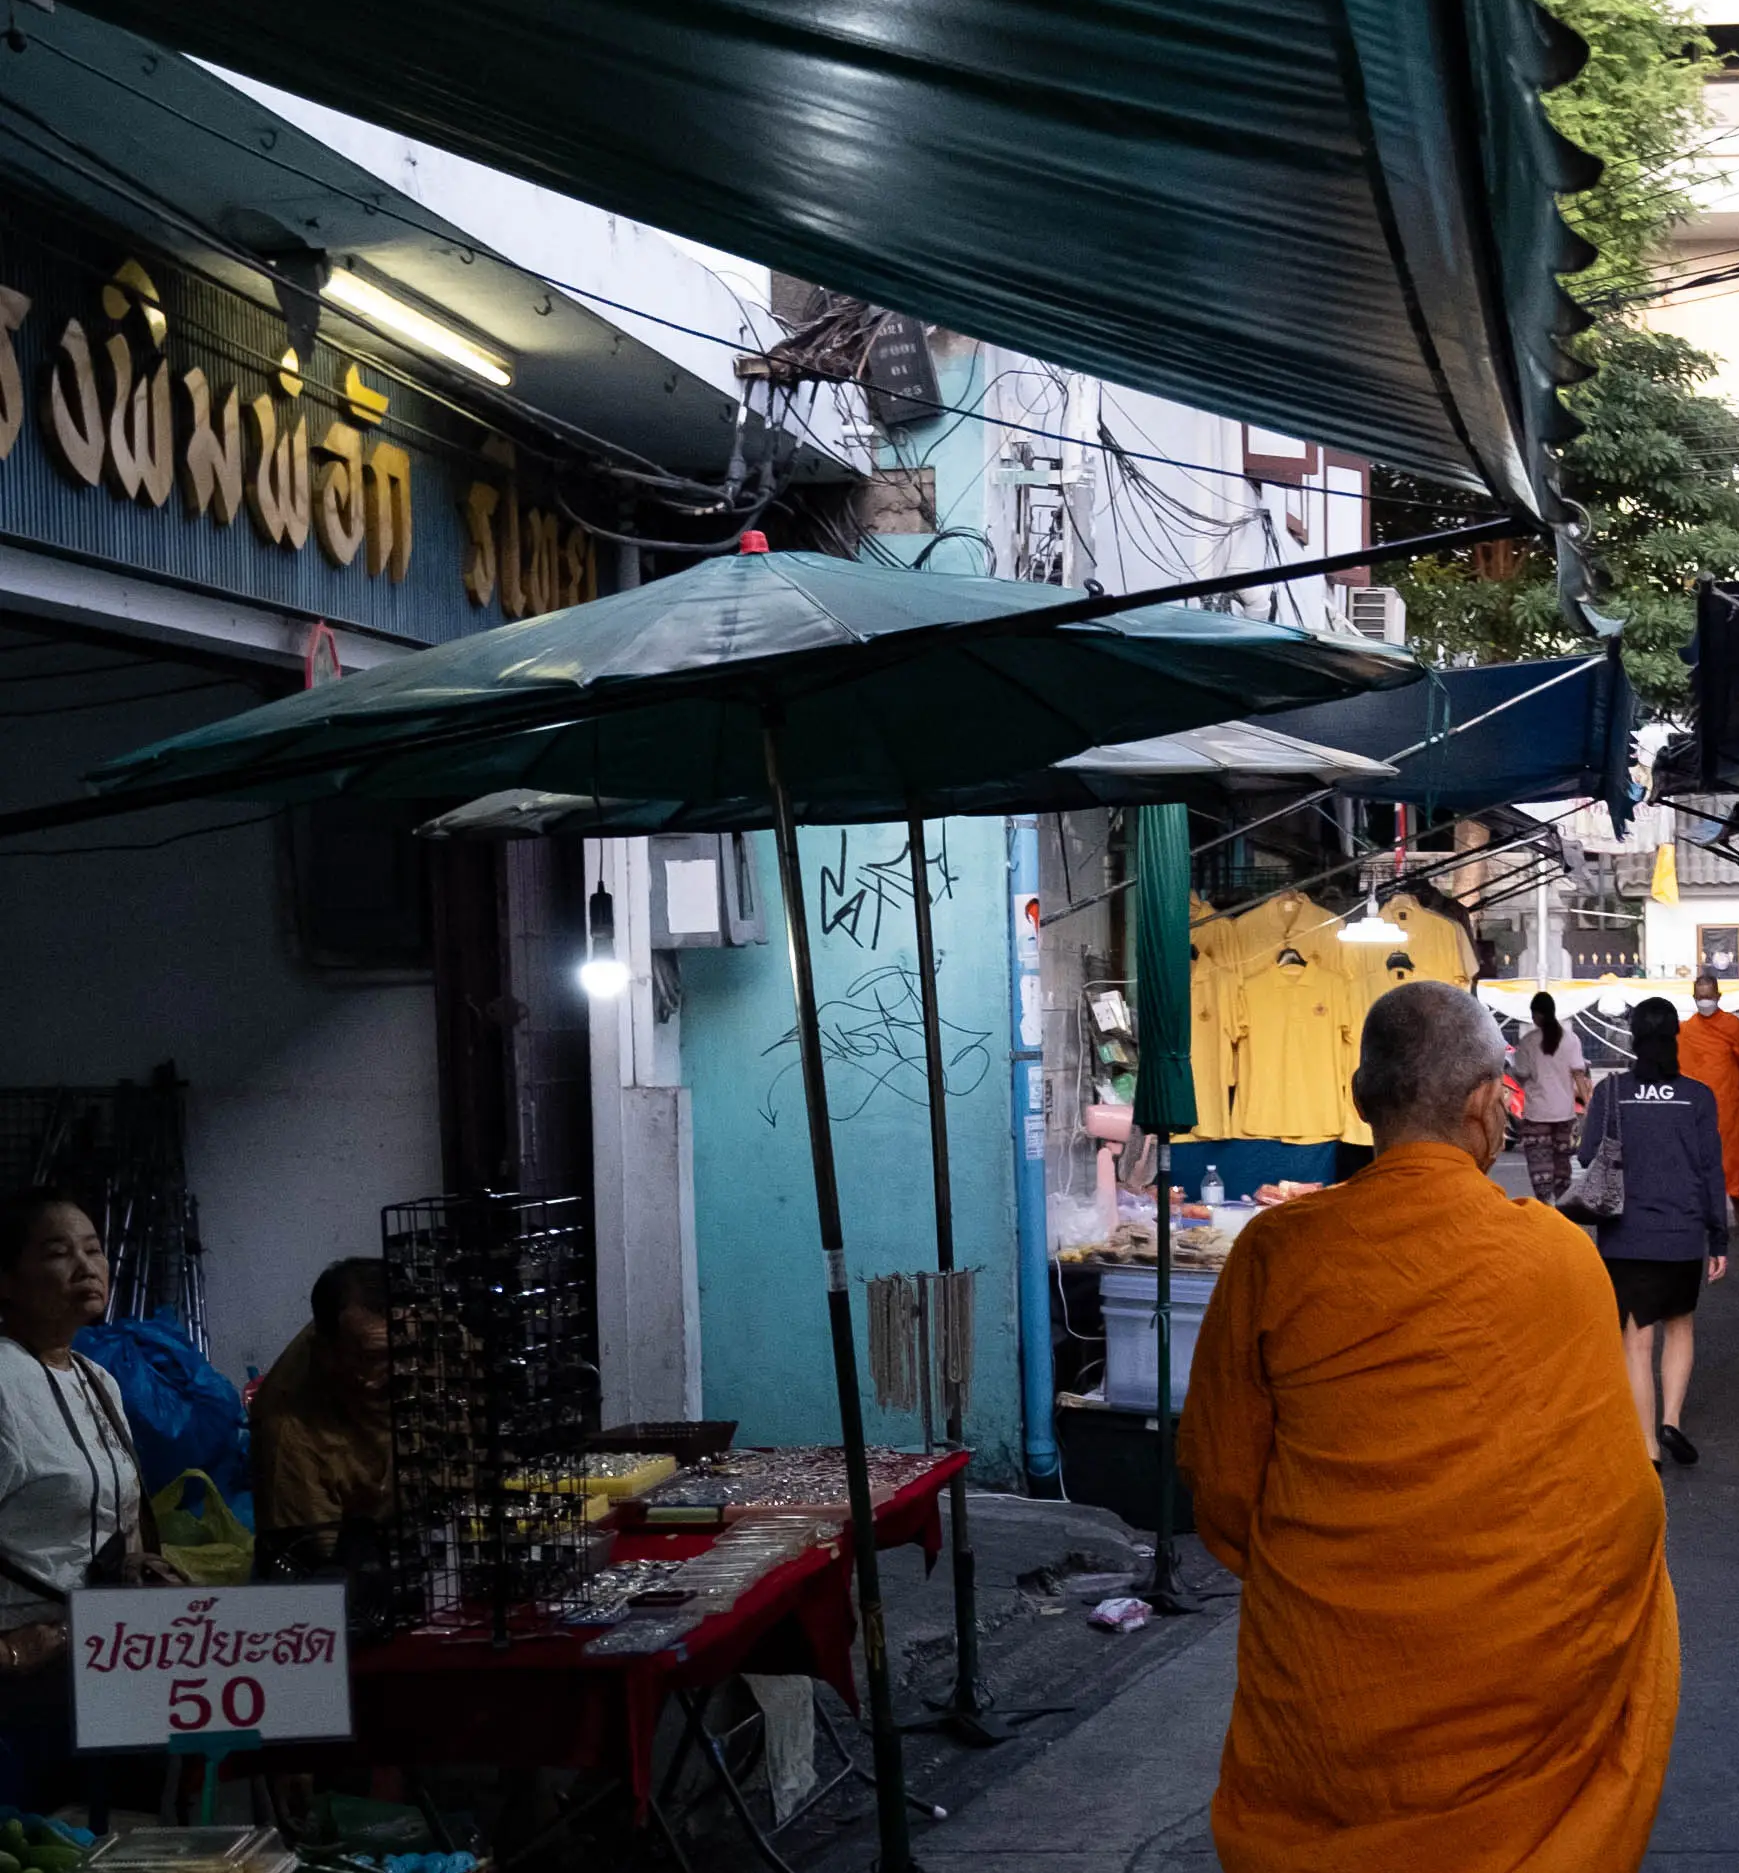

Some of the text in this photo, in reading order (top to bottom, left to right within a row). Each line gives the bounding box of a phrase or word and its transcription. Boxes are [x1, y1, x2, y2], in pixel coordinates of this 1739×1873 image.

[1634, 1084, 1675, 1100] JAG
[85, 1597, 337, 1672] ปอเปี๊ยะสด
[168, 1676, 267, 1730] 50
